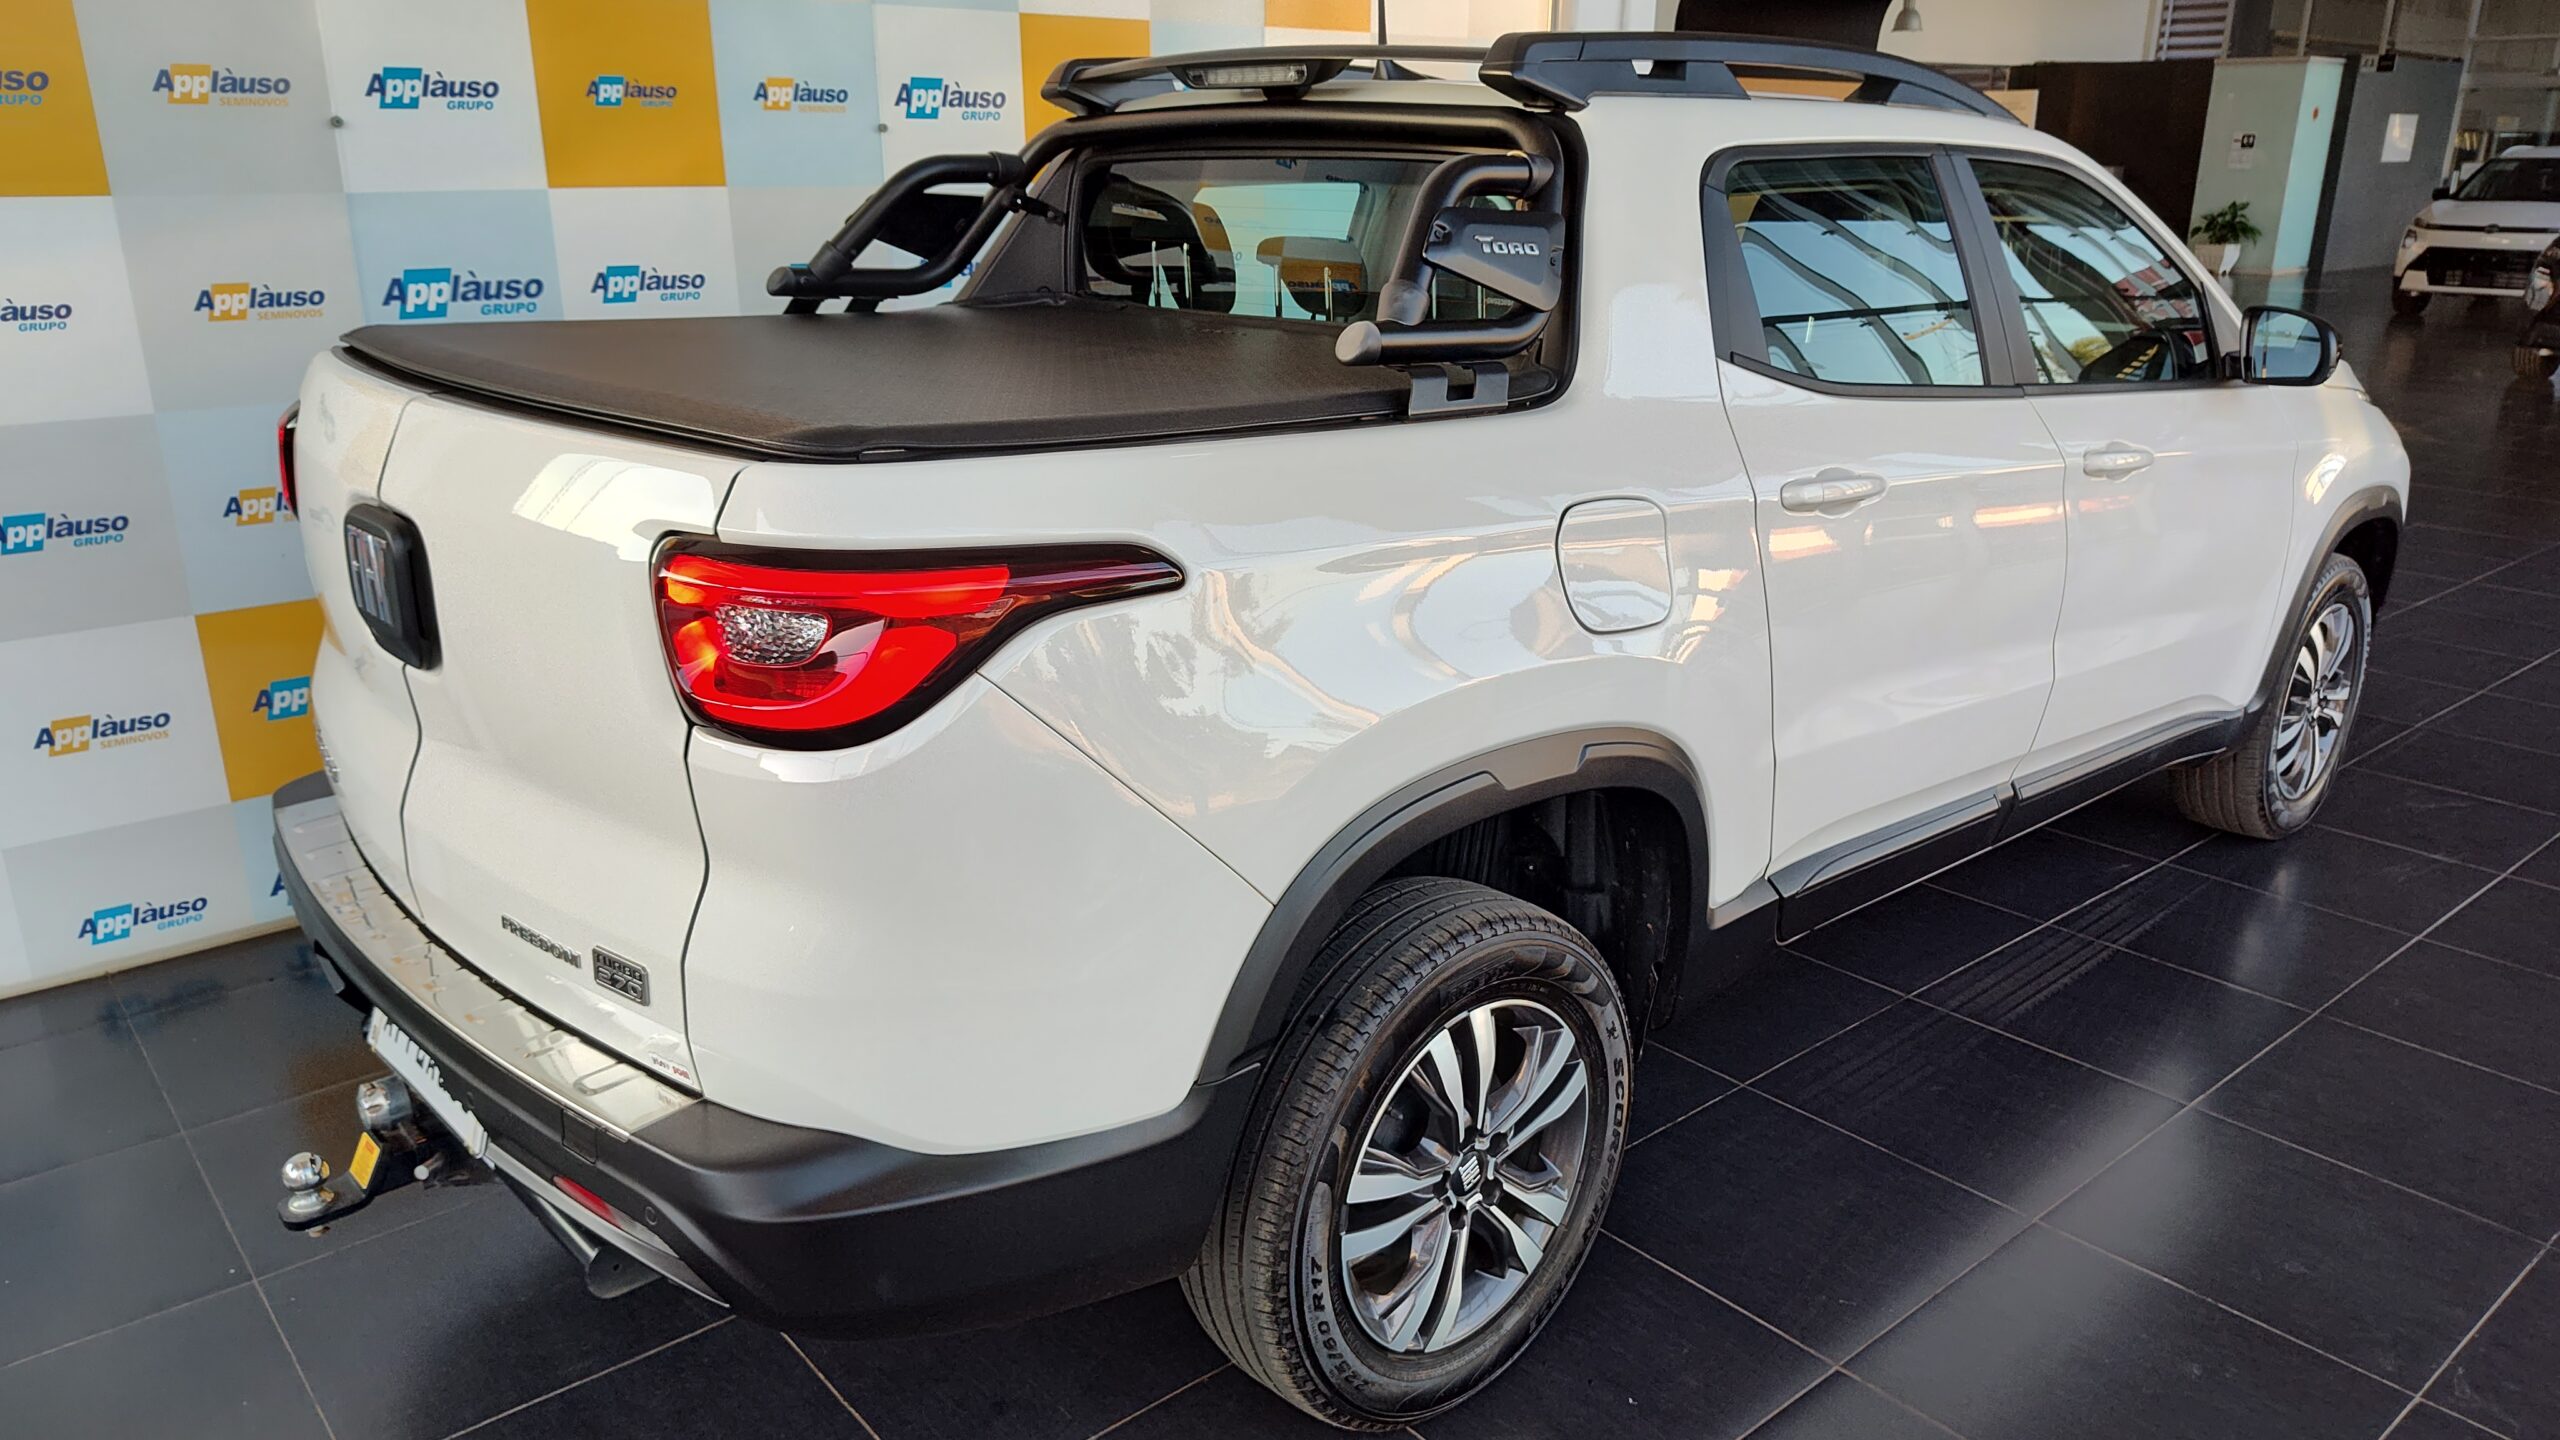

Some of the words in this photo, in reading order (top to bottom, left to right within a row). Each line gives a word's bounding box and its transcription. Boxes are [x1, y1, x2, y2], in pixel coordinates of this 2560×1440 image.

[152, 68, 290, 99] Applàuso
[365, 71, 499, 104] Applàuso
[586, 79, 677, 103] Applàuso
[753, 81, 848, 107] Applàuso
[894, 82, 1006, 113] Applàuso
[0, 94, 42, 106] UPO
[447, 101, 494, 110] GRUPO
[961, 111, 1001, 120] GRUPO
[1474, 235, 1540, 256] TORO
[382, 271, 544, 312] Applàuso
[591, 267, 706, 299] Applàuso
[660, 291, 701, 301] GRUPO
[194, 285, 325, 316] Applàuso
[480, 302, 537, 315] GRUPO
[18, 321, 67, 332] GRUPO
[73, 534, 124, 547] GRUPO
[33, 713, 171, 751] Applàuso
[78, 898, 208, 940] Applàuso
[157, 914, 203, 930] GRUPO
[501, 913, 582, 969] FREEDOM
[597, 966, 643, 999] 270
[1310, 1256, 1326, 1313] R17
